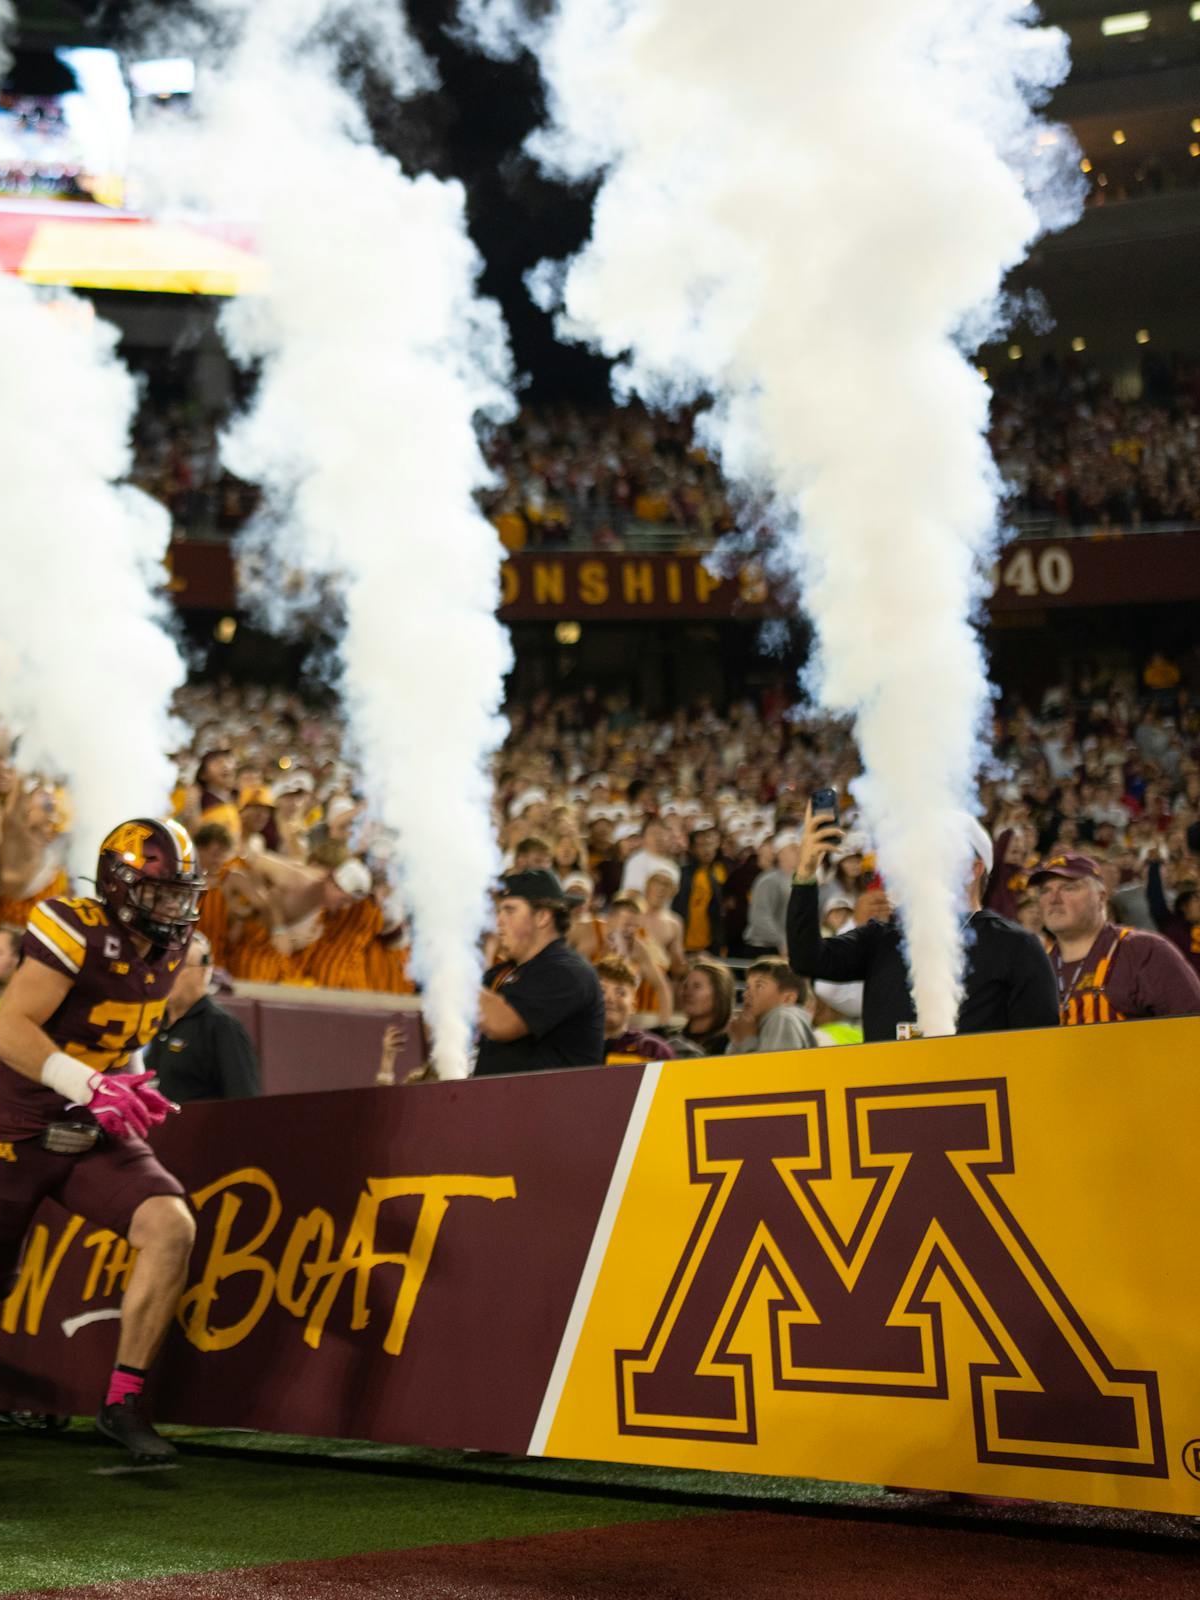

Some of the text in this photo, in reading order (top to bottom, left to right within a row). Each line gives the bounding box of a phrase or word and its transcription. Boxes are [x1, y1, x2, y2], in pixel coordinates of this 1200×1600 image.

[83, 1229, 139, 1300] TH
[176, 1167, 517, 1356] BOAT
[614, 1077, 1169, 1479] M
